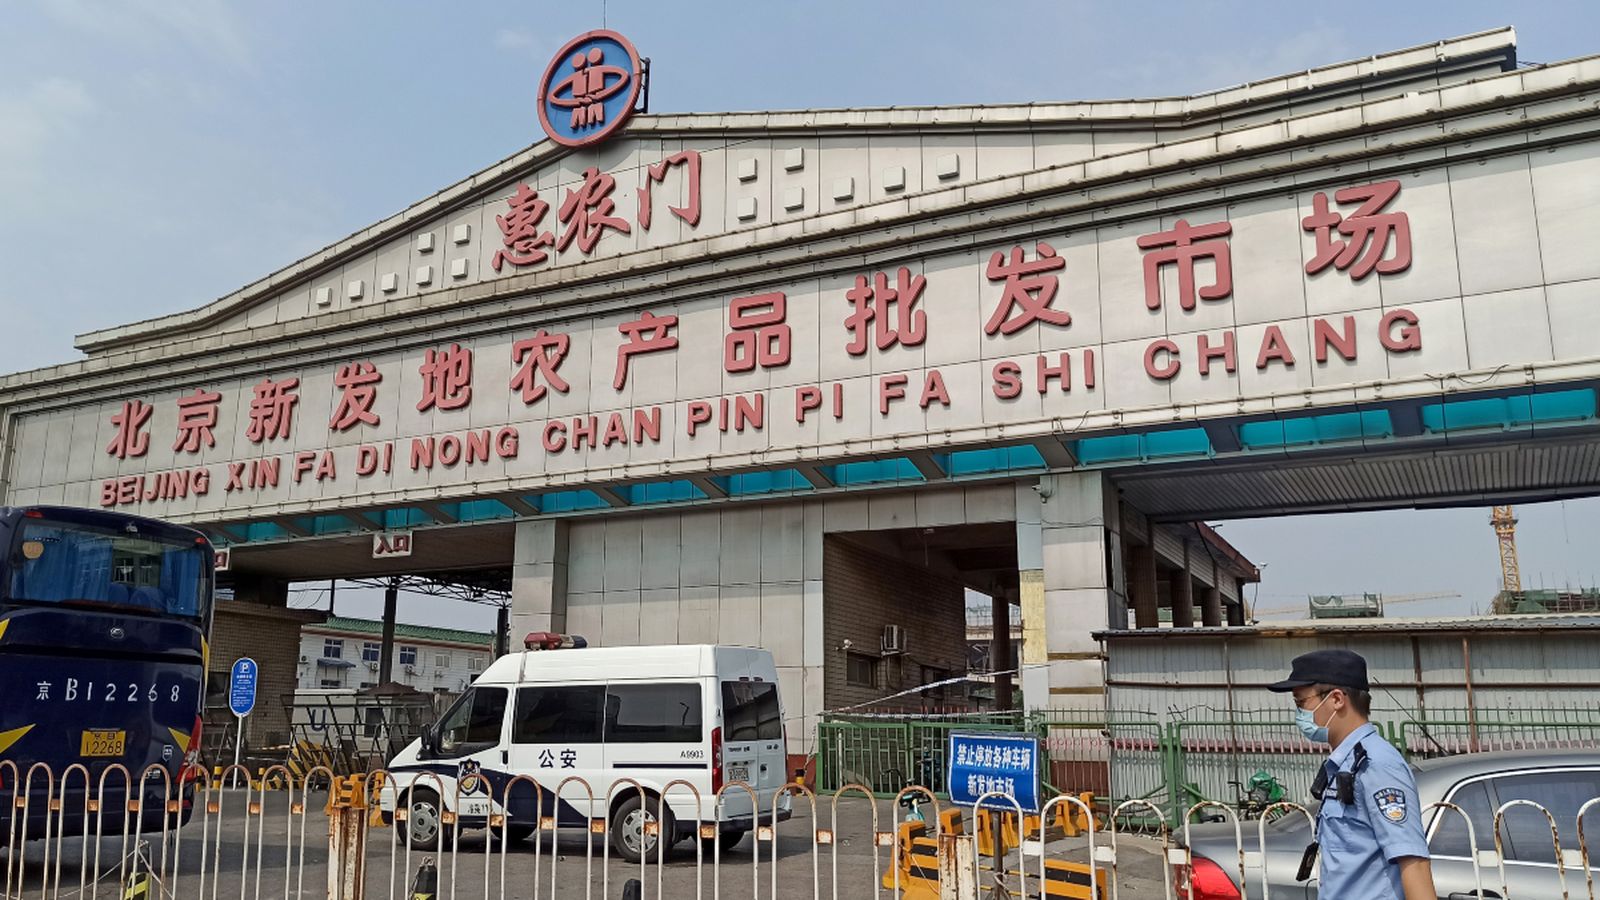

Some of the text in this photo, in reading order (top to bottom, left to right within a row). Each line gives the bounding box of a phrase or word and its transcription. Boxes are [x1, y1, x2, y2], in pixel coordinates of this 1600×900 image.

[492, 150, 702, 272] 惠农门
[106, 180, 1412, 460] 北京新发地农产品批发市场
[101, 308, 1422, 507] BEIJING XIN FA DI NONG CHAN PIN PI FA SHI CHANG
[375, 535, 411, 555] 入口
[241, 662, 249, 674] P
[85, 740, 122, 754] 12268
[538, 748, 577, 769] 公安
[956, 743, 1031, 770] 禁止停放各种车辆
[967, 773, 1016, 799] 新发地市场
